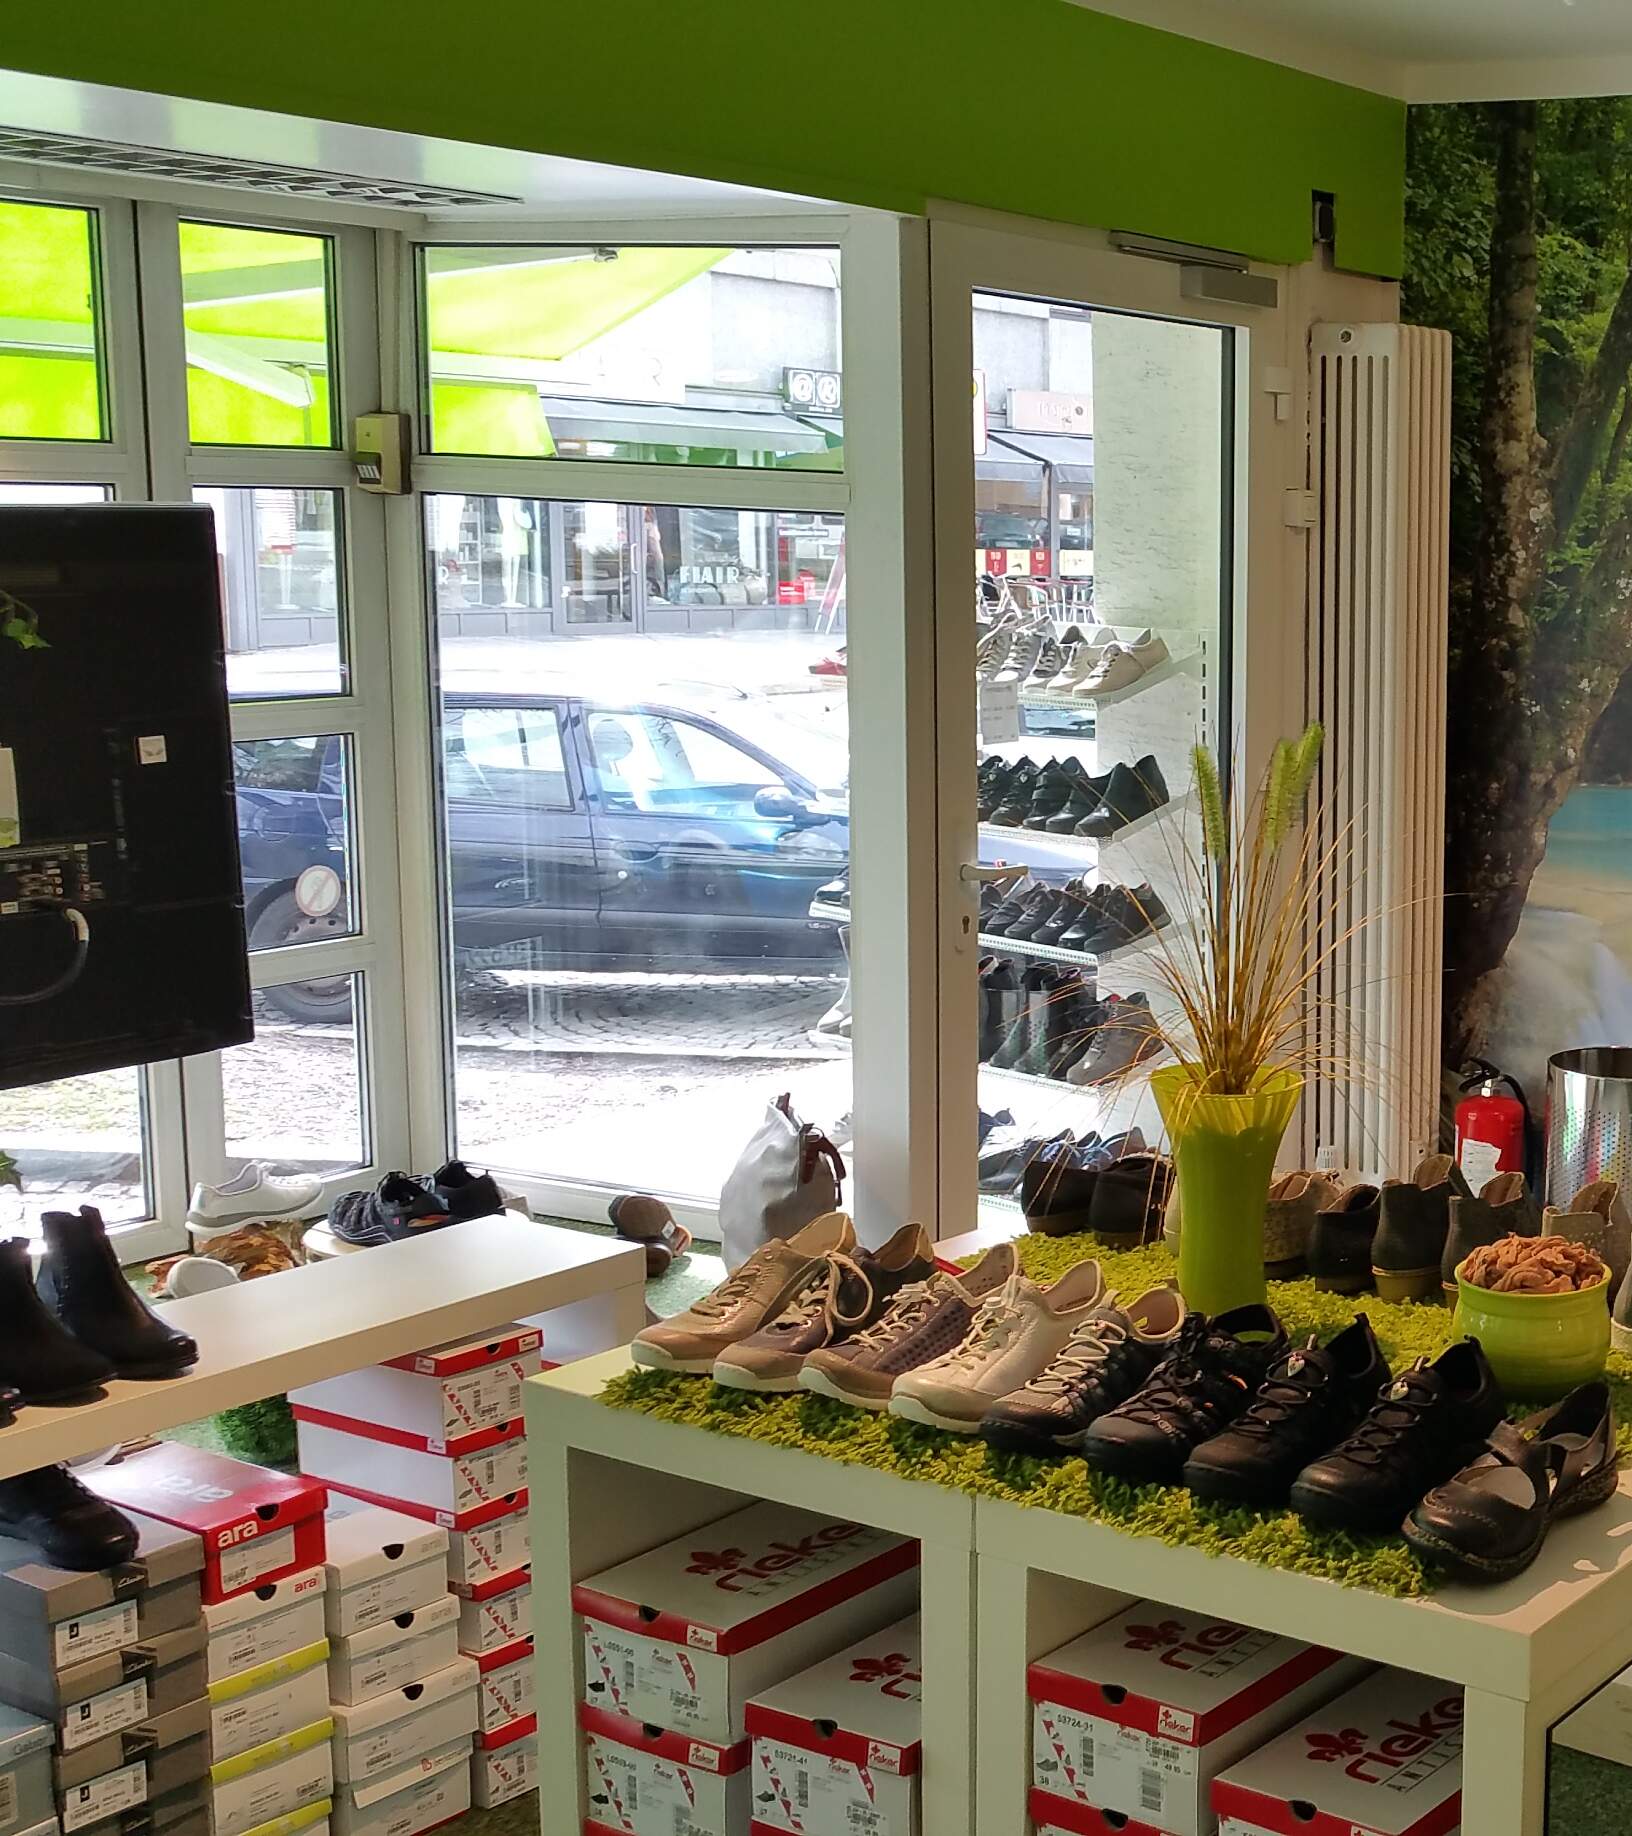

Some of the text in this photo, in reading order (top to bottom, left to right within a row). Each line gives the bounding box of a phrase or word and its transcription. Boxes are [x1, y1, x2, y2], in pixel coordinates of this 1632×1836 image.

[218, 1521, 258, 1548] ara
[714, 1524, 866, 1593] rieke
[294, 1577, 317, 1593] ara
[1345, 1697, 1464, 1785] rieke
